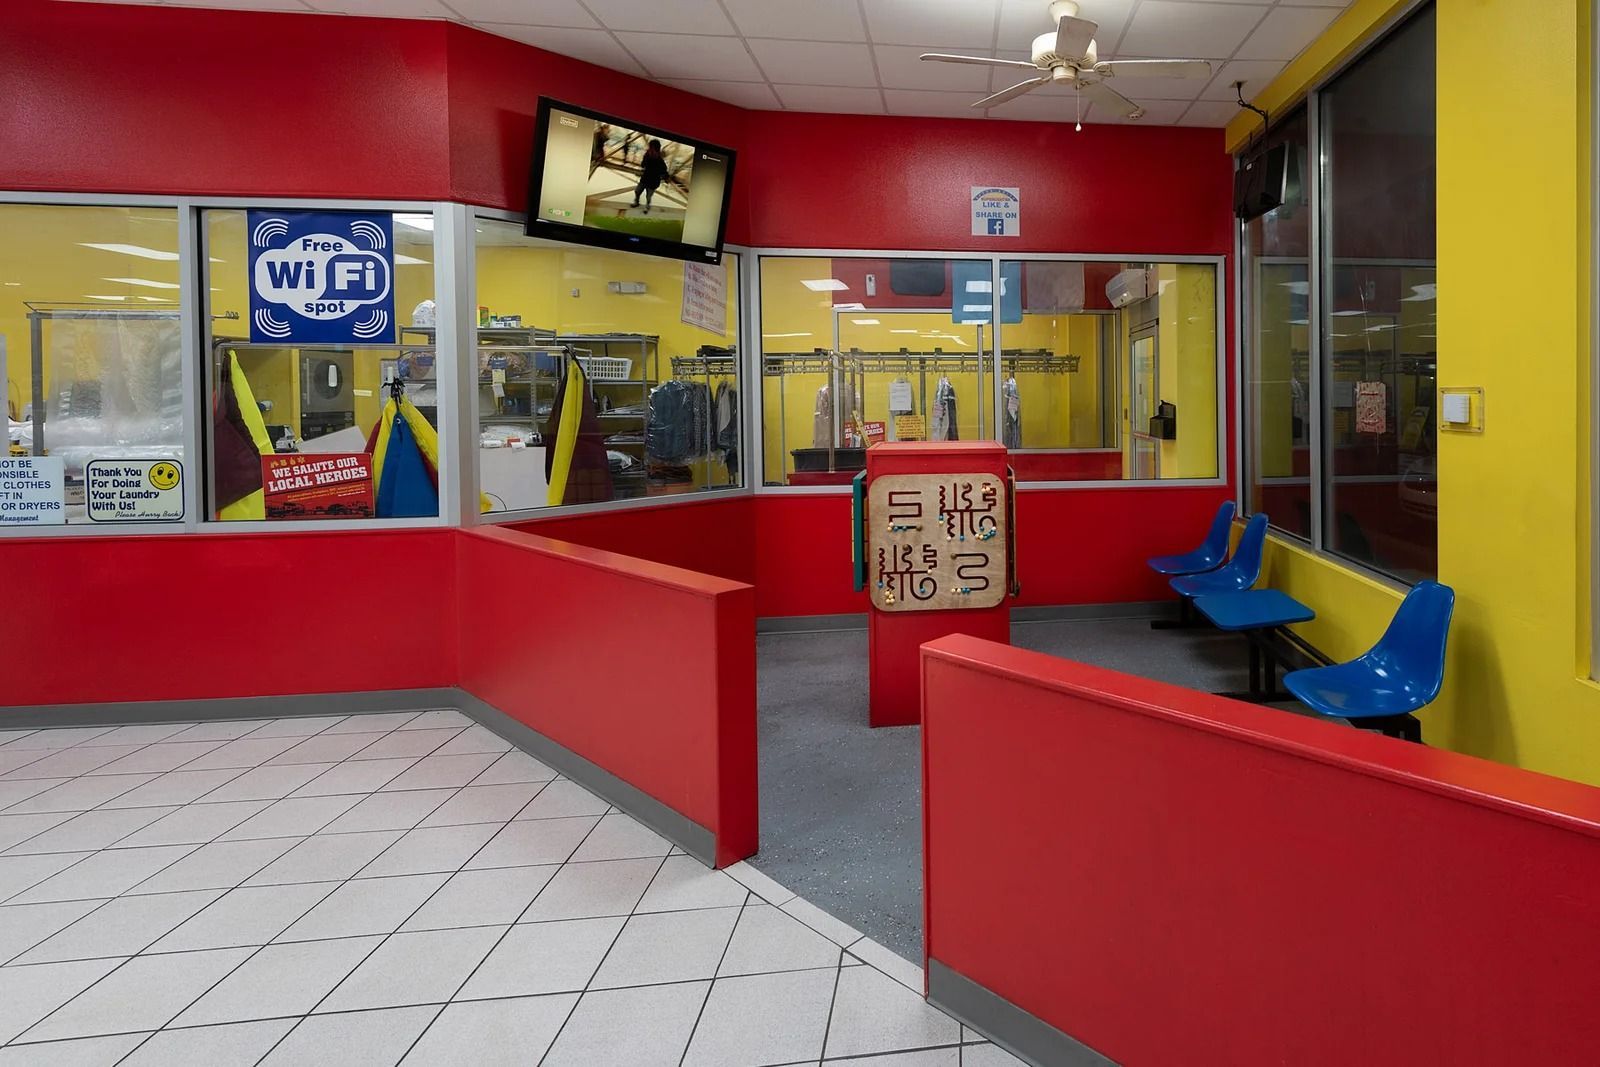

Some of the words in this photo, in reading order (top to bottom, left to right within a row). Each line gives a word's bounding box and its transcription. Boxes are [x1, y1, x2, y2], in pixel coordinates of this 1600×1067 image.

[302, 238, 343, 252] Free
[266, 260, 315, 289] Wi
[334, 261, 375, 290] Fi
[304, 301, 345, 316] spot
[0, 460, 15, 468] OT
[18, 460, 32, 468] BE
[272, 467, 291, 479] WE
[293, 460, 335, 476] SALUTE
[336, 456, 359, 469] OUR
[91, 467, 121, 477] Thank
[123, 467, 142, 477] You
[91, 479, 109, 488] For
[112, 478, 141, 488] Doing
[268, 475, 313, 492] LOCAL
[315, 466, 368, 485] HEROES
[3, 480, 51, 489] CLOTHES
[12, 491, 23, 500] IN
[91, 490, 116, 499] Your
[119, 490, 159, 499] Laundry
[1, 502, 16, 510] OR
[19, 501, 60, 510] DRYERS
[92, 501, 116, 511] With
[118, 501, 136, 511] Us!
[114, 510, 136, 518] Please
